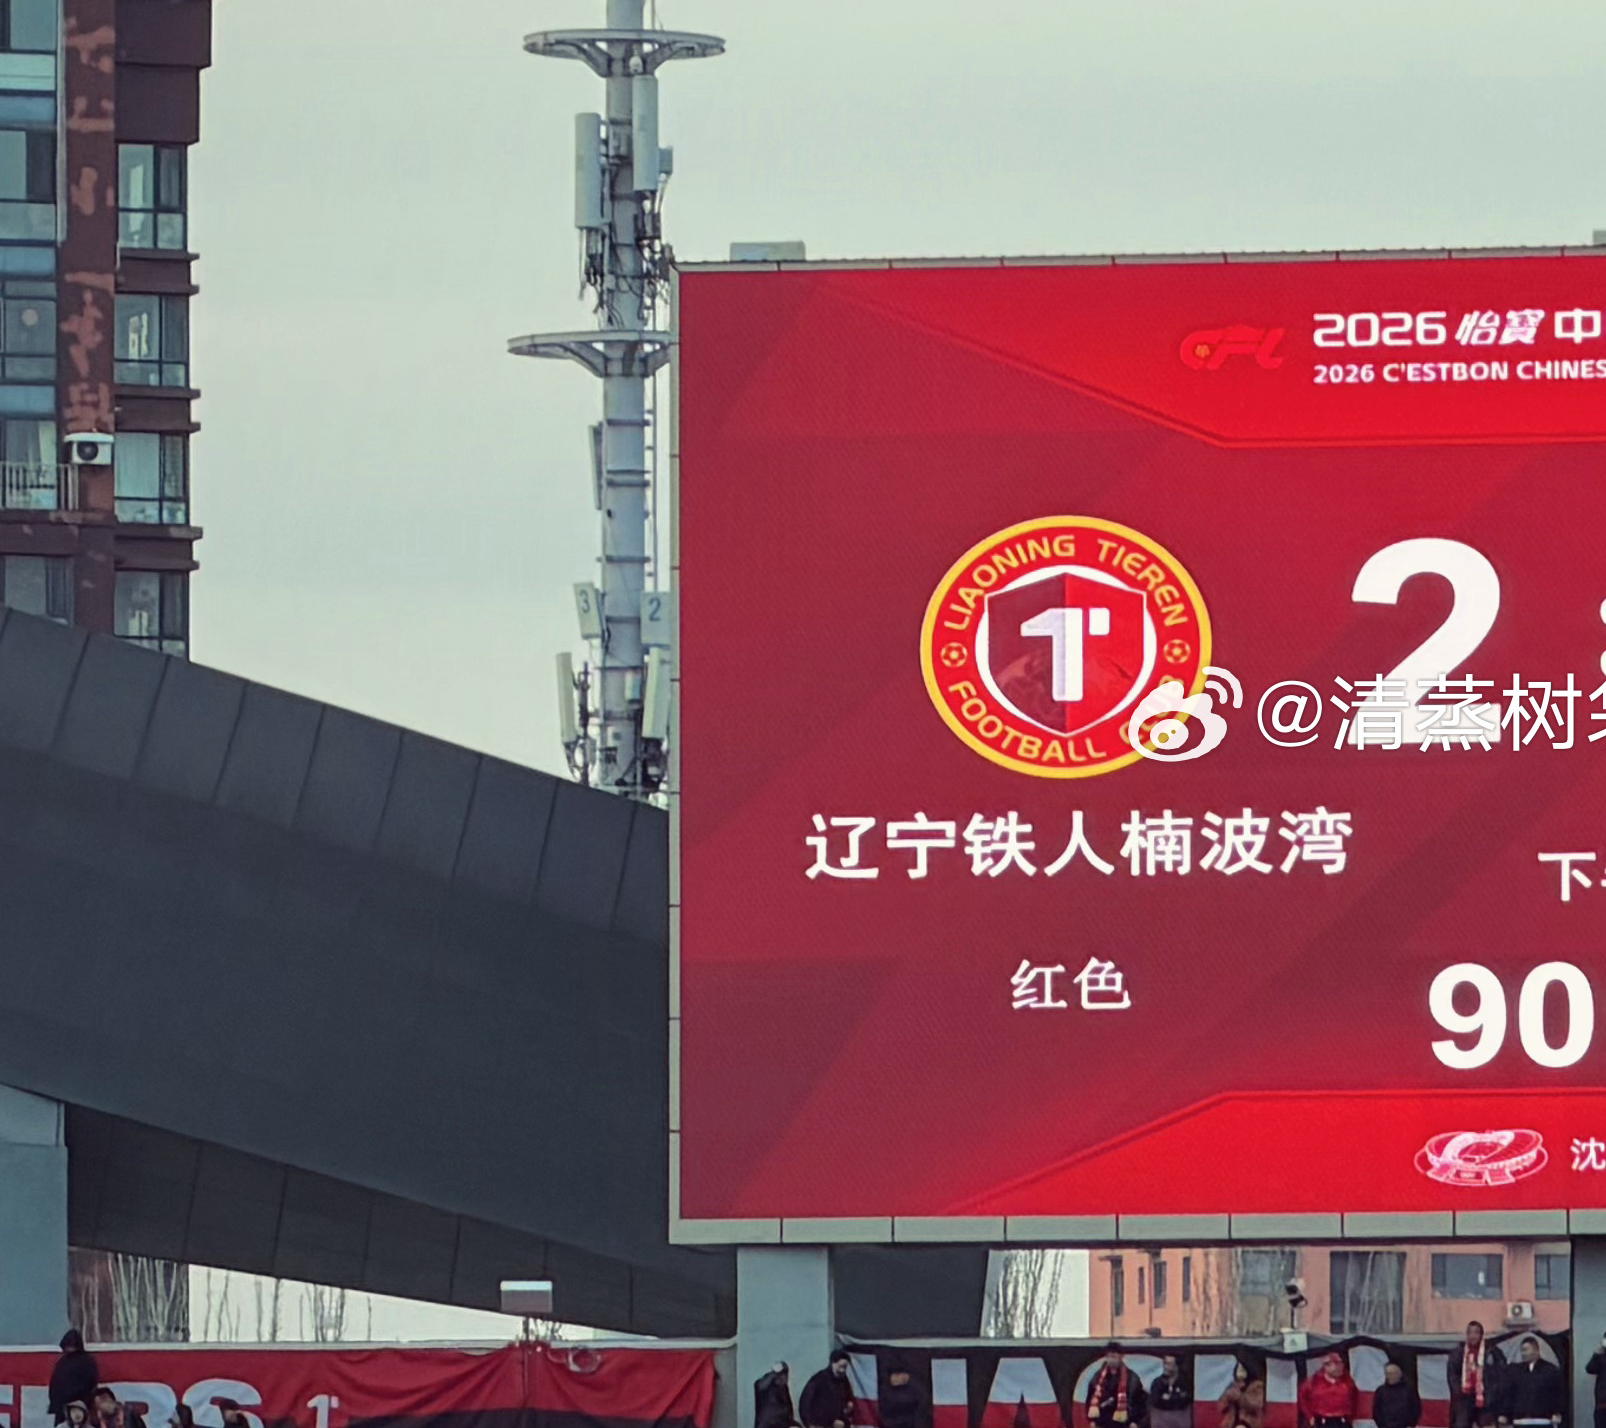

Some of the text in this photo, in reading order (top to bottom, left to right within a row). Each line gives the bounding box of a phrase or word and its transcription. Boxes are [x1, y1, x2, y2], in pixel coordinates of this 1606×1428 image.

[1313, 311, 1447, 347] 2026
[1313, 364, 1375, 384] 2026
[1382, 362, 1508, 382] C'ESTBON
[648, 597, 661, 622] 2
[943, 535, 1188, 631] LIAONING TIEREN
[948, 679, 1107, 763] FOOTBALL
[804, 806, 1353, 879] 辽宁铁人楠波湾
[1009, 956, 1132, 1010] 红色
